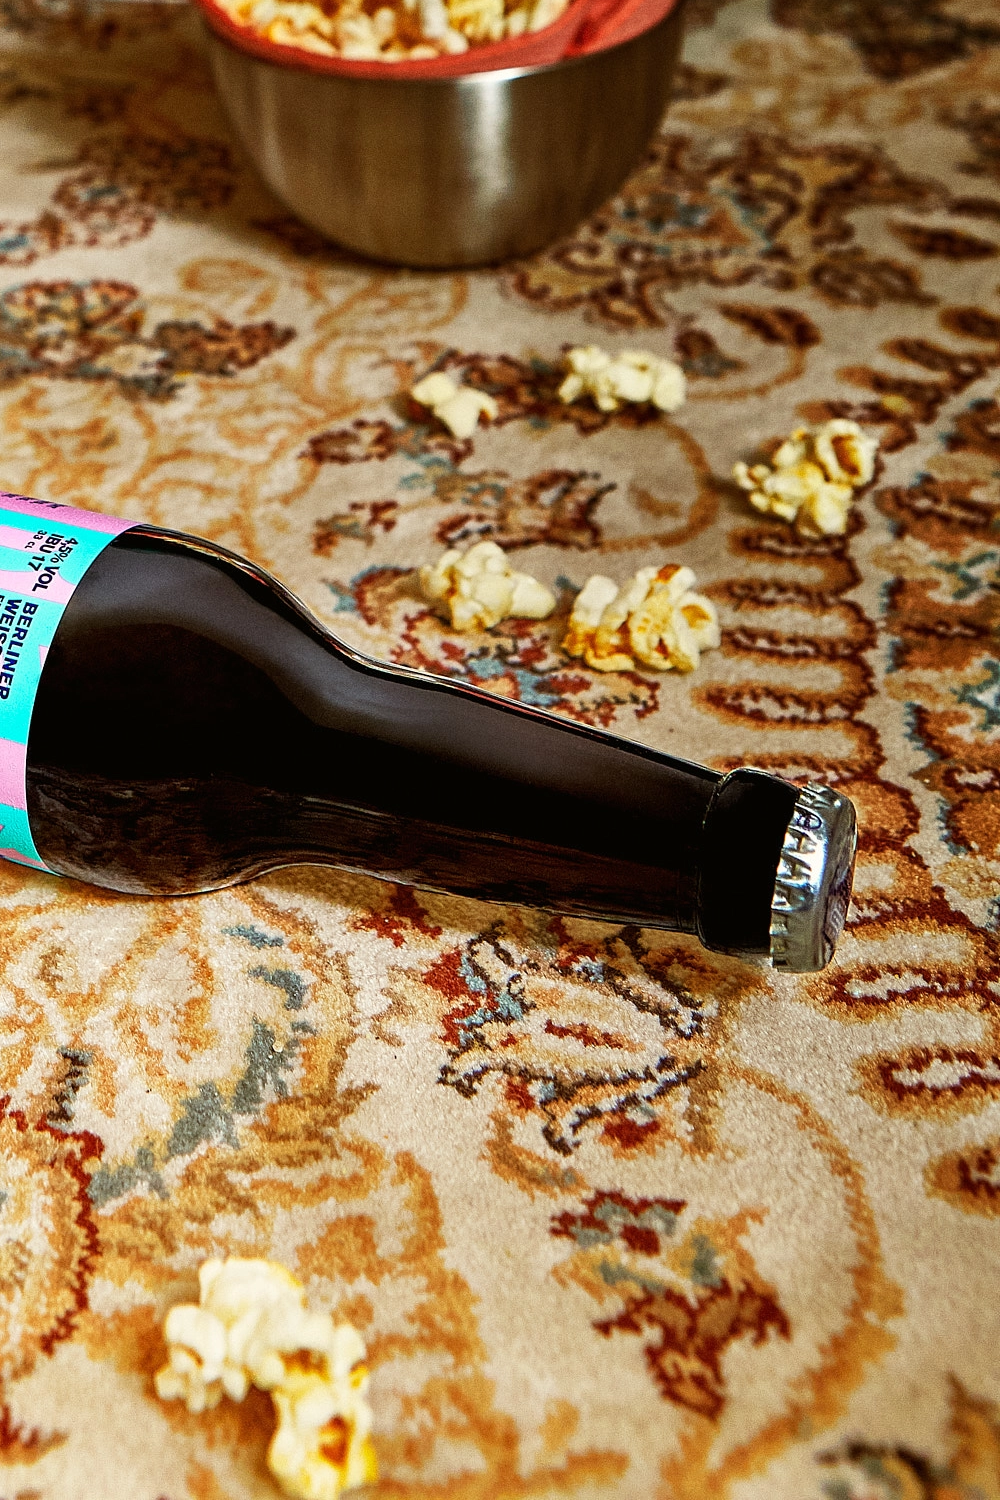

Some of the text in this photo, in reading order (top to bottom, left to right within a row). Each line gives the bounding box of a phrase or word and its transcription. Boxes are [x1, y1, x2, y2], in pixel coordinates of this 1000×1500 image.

[33, 529, 47, 541] 33
[28, 533, 65, 572] IBU 17
[32, 566, 60, 592] VOL
